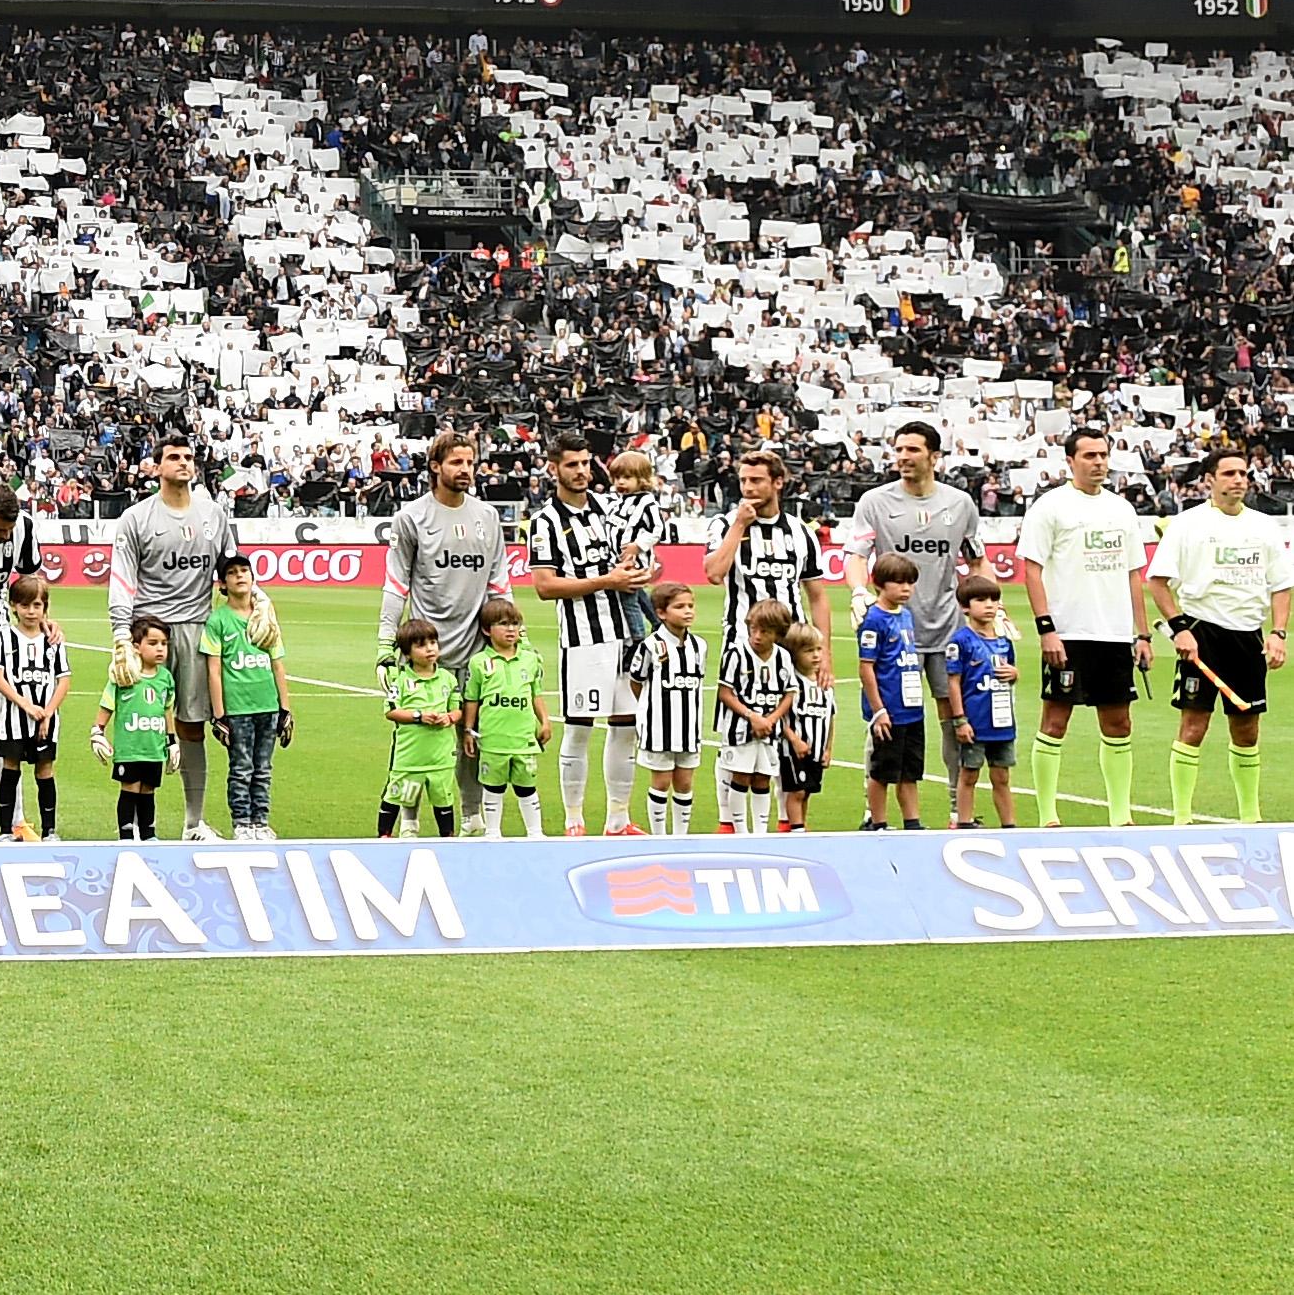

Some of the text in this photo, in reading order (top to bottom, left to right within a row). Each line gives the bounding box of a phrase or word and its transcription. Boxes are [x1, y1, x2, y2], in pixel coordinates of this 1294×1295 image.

[895, 535, 950, 556] Jeep
[163, 551, 210, 572] Jeep
[434, 550, 484, 571] Jeep
[744, 559, 795, 581] Jeep
[13, 668, 50, 686] Jeep
[662, 675, 699, 691] Jeep
[489, 693, 528, 711] Jeep
[588, 689, 600, 712] 9
[125, 712, 166, 735] Jeep
[693, 867, 818, 917] TIM
[942, 831, 1273, 933] SERIE
[101, 849, 207, 947] A
[192, 848, 466, 944] TIM
